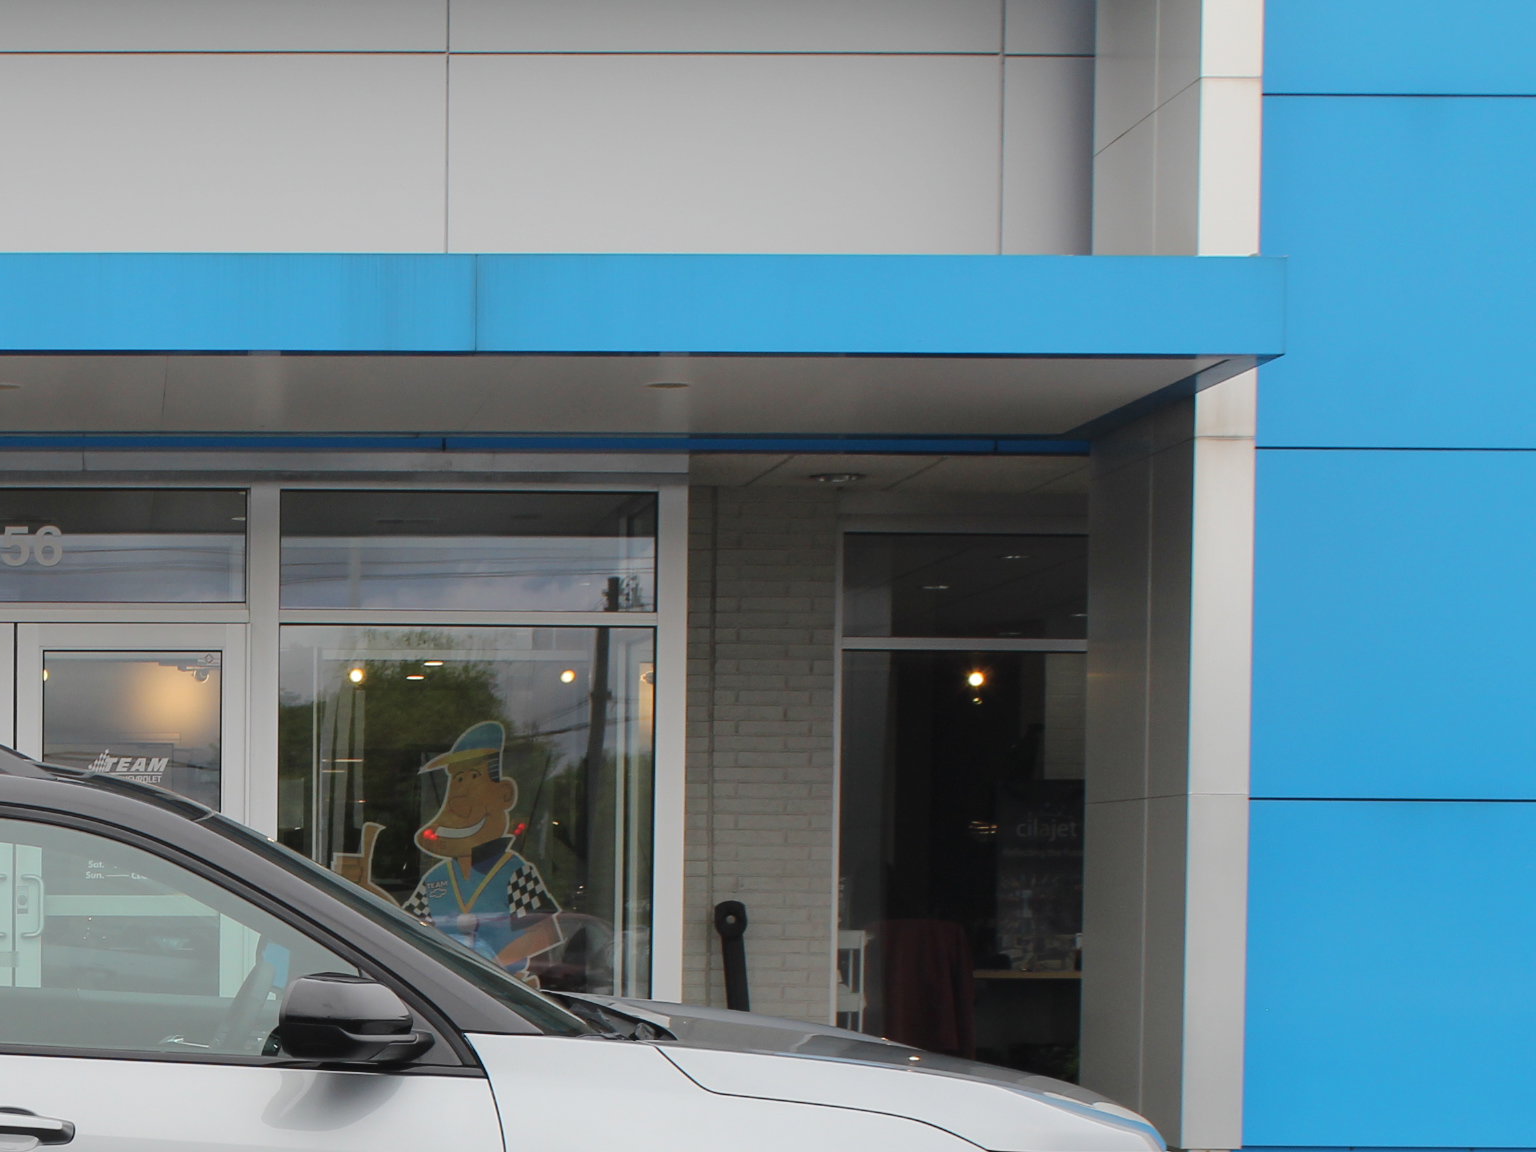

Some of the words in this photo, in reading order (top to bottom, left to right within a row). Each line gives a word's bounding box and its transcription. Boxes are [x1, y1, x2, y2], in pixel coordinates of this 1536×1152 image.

[104, 757, 169, 772] TEAM
[1016, 817, 1077, 842] cilajet
[427, 880, 449, 889] TEAM
